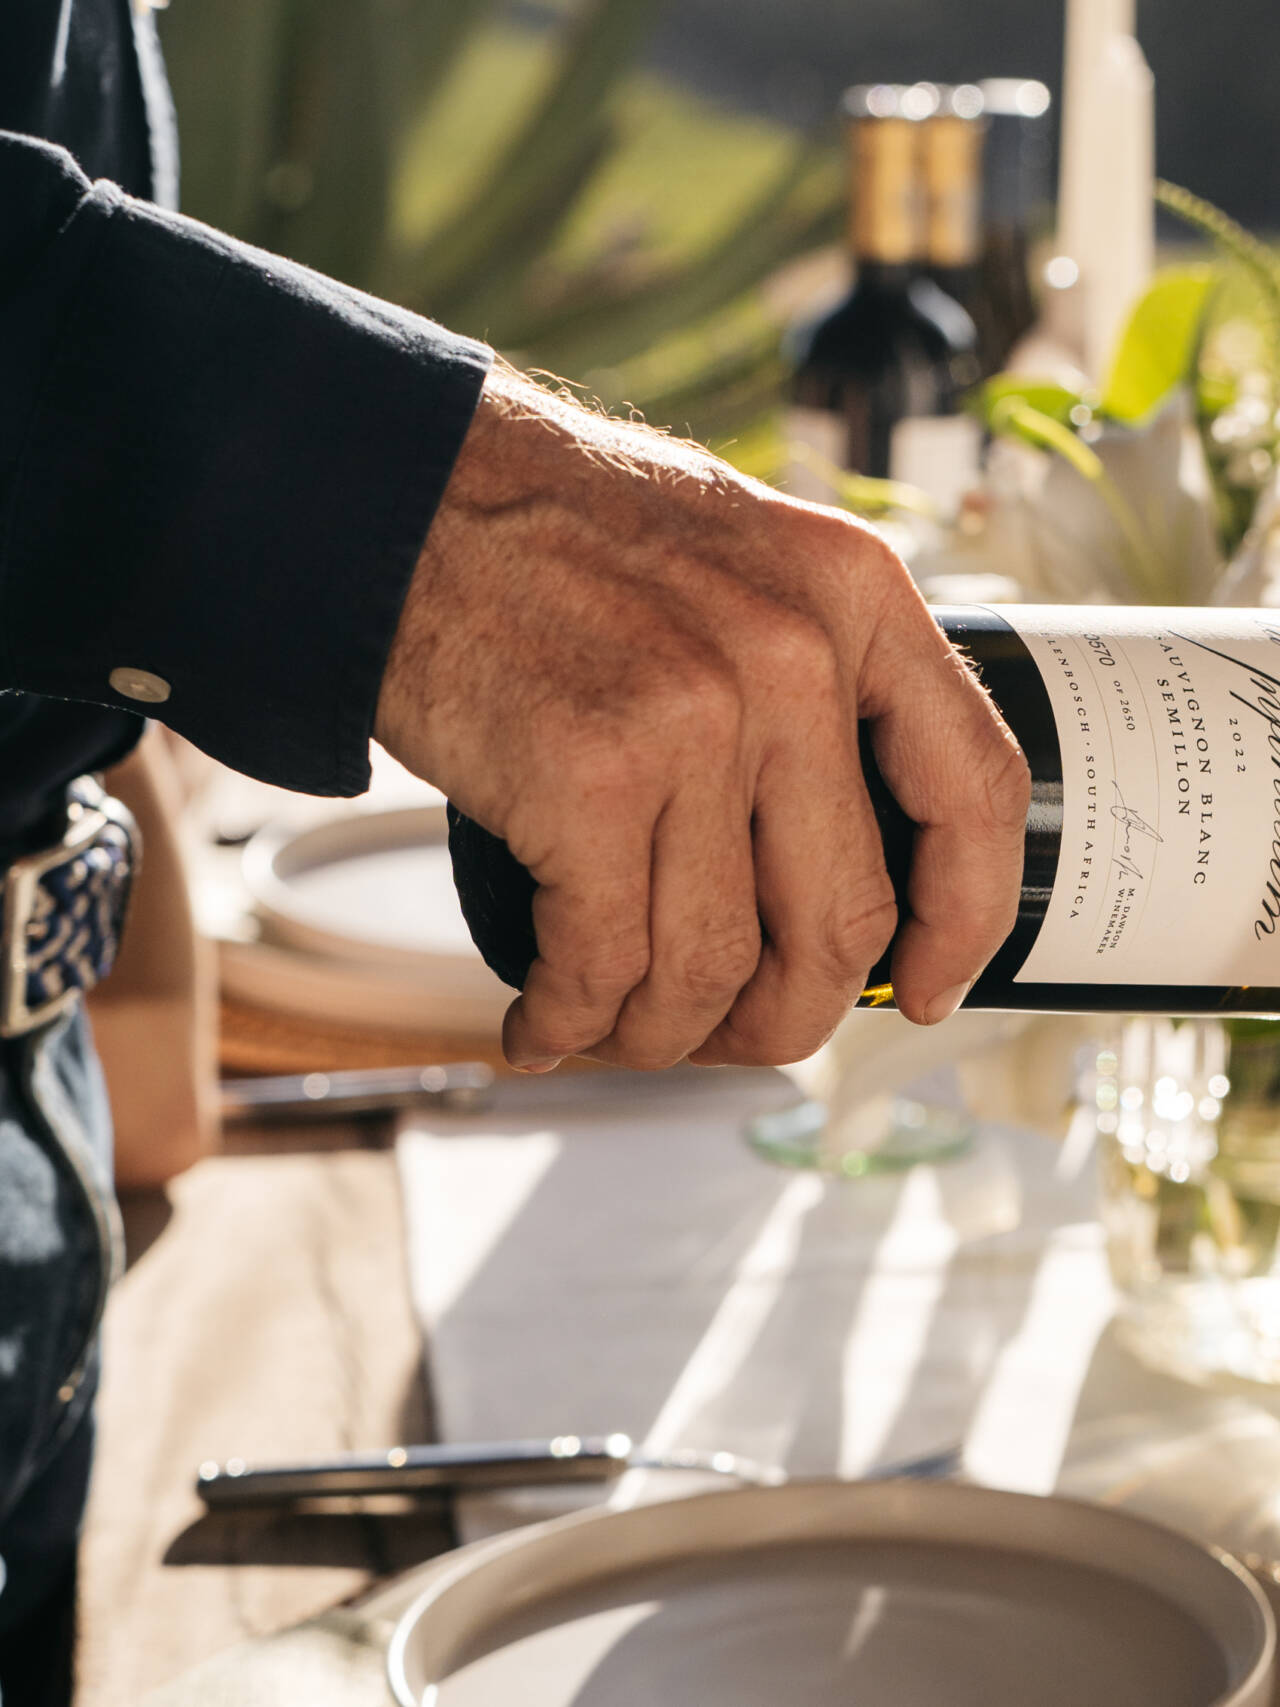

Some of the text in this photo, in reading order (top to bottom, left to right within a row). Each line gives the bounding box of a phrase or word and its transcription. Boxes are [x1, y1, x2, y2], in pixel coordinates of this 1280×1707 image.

[1120, 700, 1136, 731] 2650
[1156, 678, 1190, 816] SEMILLON
[1228, 718, 1246, 773] 2022
[1085, 755, 1097, 831] SOUTH
[1193, 793, 1213, 885] BLANC
[1069, 841, 1094, 919] AFRICA
[1096, 888, 1126, 955] WINEMAKER
[1109, 887, 1136, 949] M. DAWSON
